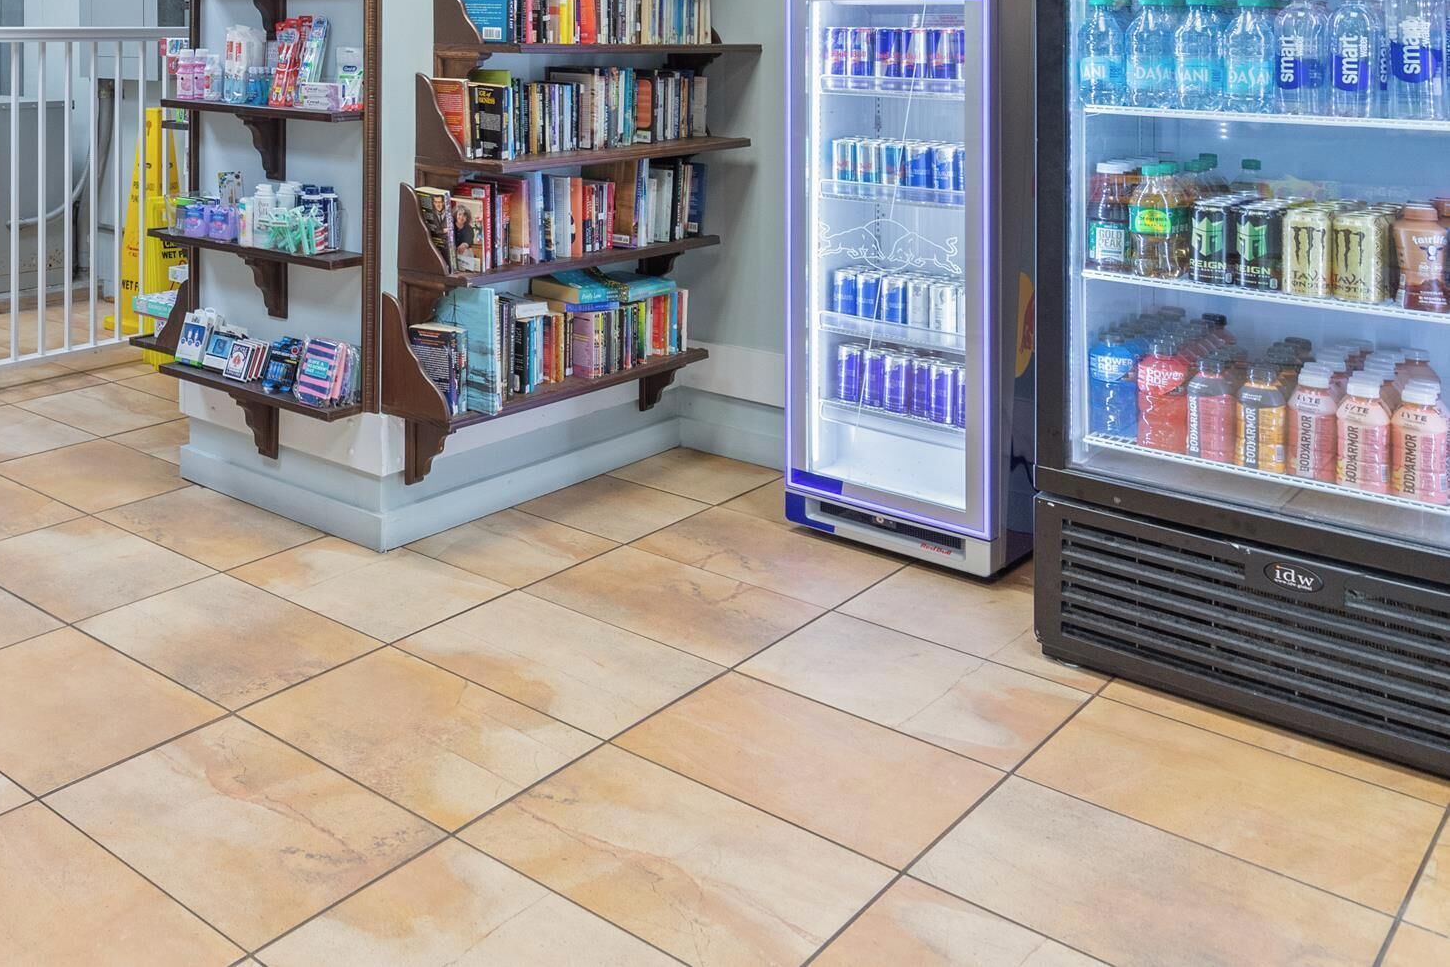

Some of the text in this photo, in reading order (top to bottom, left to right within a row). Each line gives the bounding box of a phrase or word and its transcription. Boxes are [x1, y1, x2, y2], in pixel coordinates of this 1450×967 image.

[1278, 34, 1295, 83] smart
[1338, 34, 1359, 84] smart
[161, 251, 177, 259] WET
[1190, 258, 1227, 270] REIGN
[1189, 395, 1198, 453] BODYARMOR
[1274, 564, 1315, 587] idw
